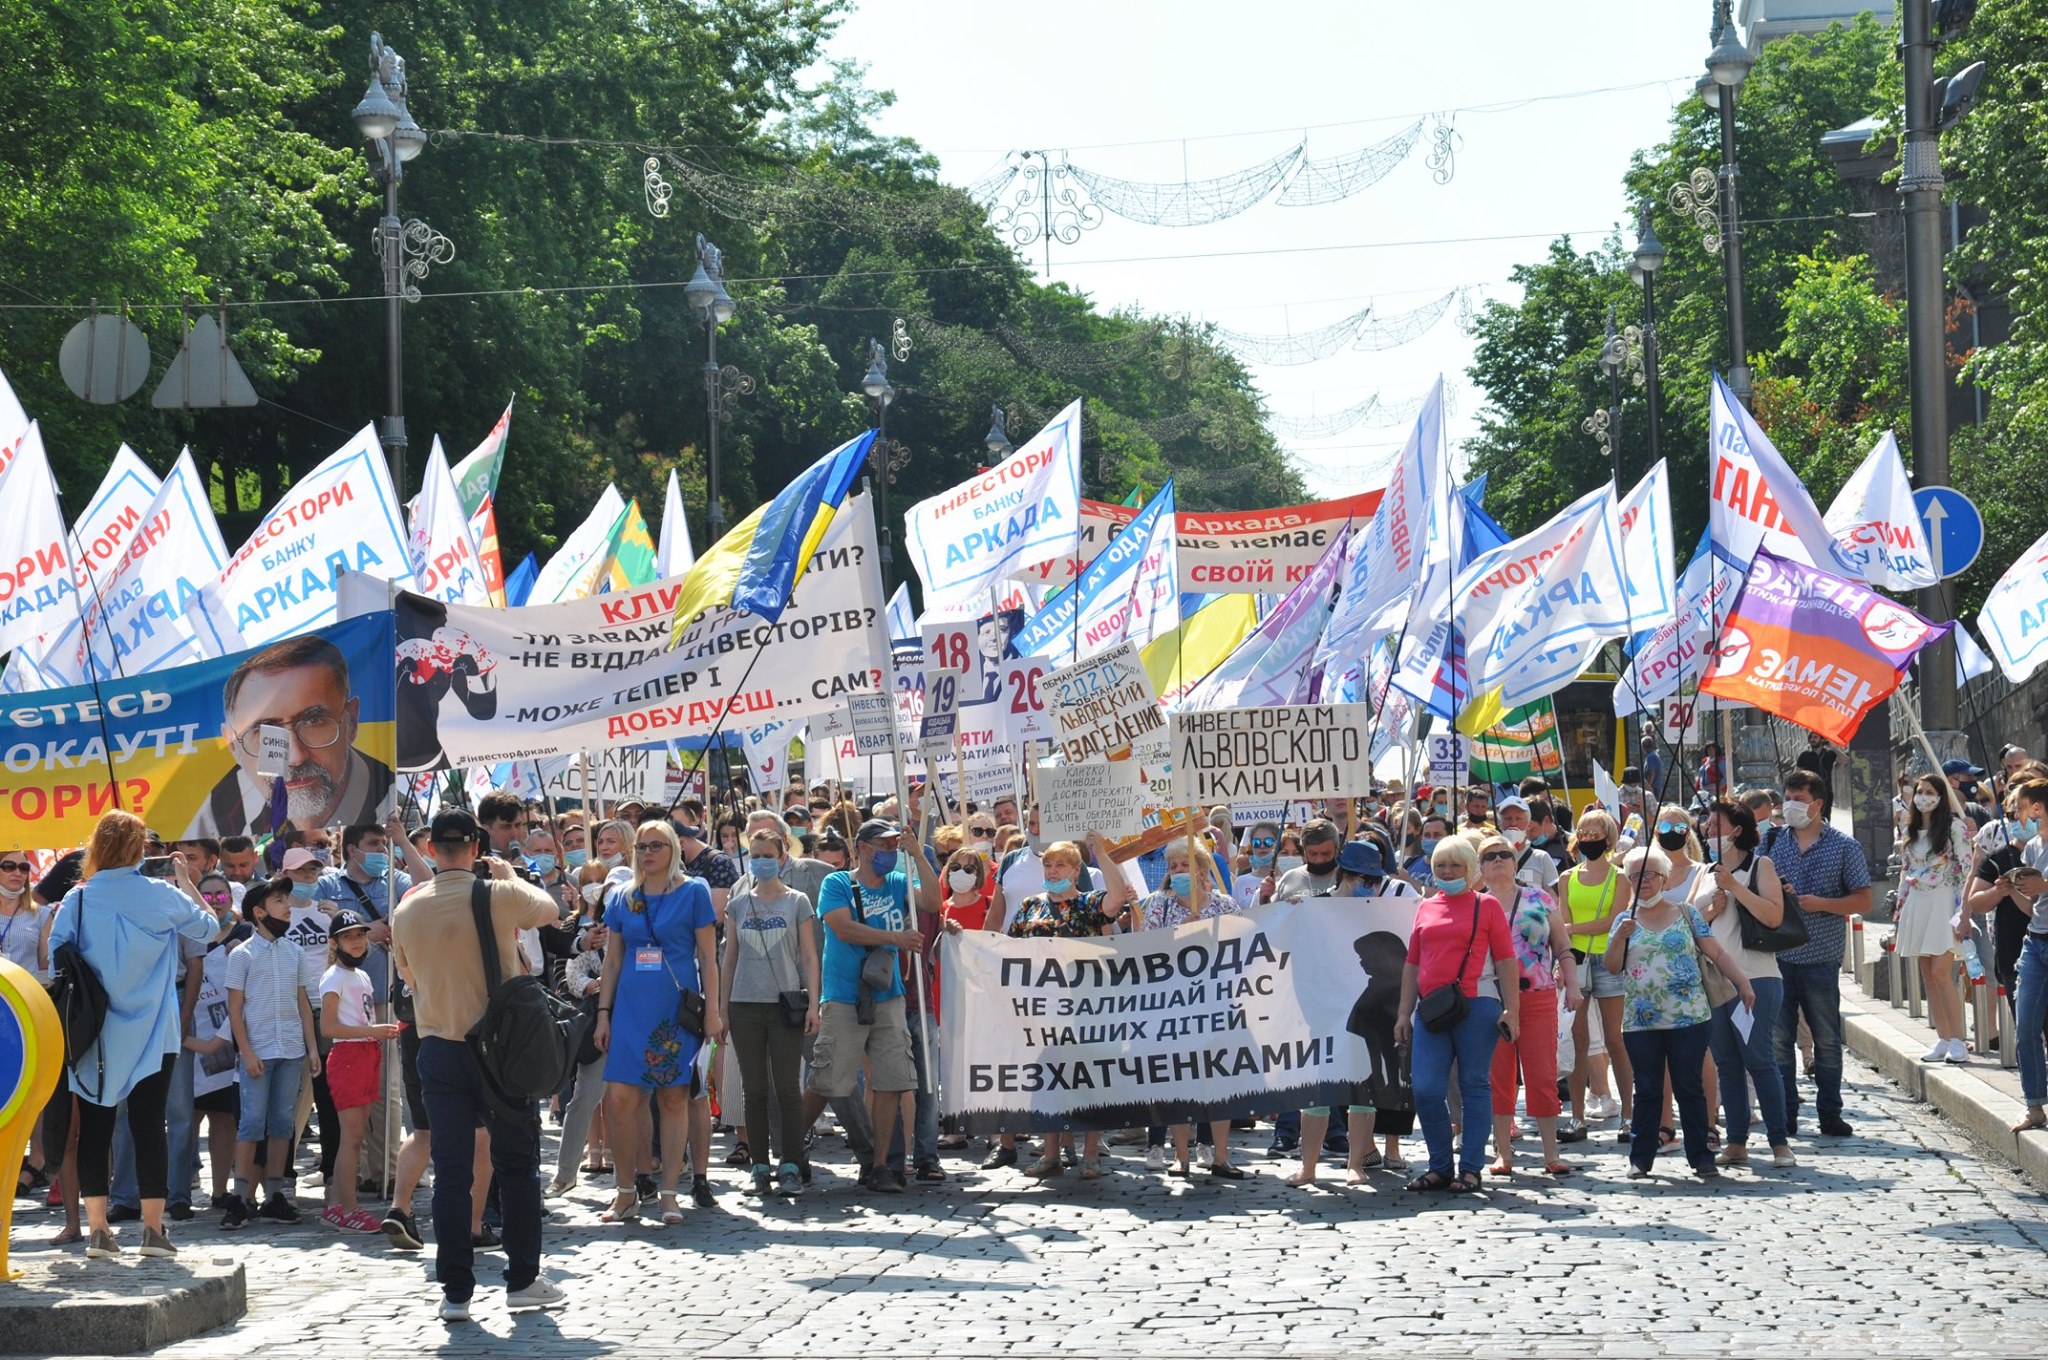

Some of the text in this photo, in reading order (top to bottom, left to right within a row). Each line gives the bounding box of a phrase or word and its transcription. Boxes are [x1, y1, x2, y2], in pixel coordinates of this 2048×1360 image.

[934, 447, 1053, 520] ІНВЕСТОРИ
[973, 489, 1024, 521] БАНКУ
[1185, 513, 1312, 535] Аркада,
[261, 533, 316, 571] БАНКУ
[945, 496, 1062, 569] АРКАДА
[1231, 529, 1327, 549] немає
[236, 540, 384, 634] АРКАДА
[1191, 559, 1274, 583] своїй
[601, 583, 682, 624] КЛИ
[684, 607, 877, 661] ІНВЕСТОРІВ?
[932, 632, 971, 674] 18
[509, 651, 556, 668] -НЕ
[505, 666, 722, 724] -МОЖЕ ТЕПЕР І
[811, 669, 884, 702] САМ?
[931, 675, 956, 714] 19
[1061, 664, 1119, 703] 2020
[1075, 685, 1114, 707] ОБМАН
[0, 691, 172, 728] ЄТЕСЬ
[607, 689, 803, 739] ДОБУДУЄШ...
[1060, 680, 1146, 733] ЛЬВОВСКИЙ
[1179, 707, 1334, 733] ИНВЕСТОРАМ
[1669, 703, 1694, 728] 20
[1182, 727, 1359, 769] ЛЬВОВСКОГО
[1435, 738, 1463, 759] 33
[0, 778, 151, 822] ОРИ?
[1200, 764, 1340, 799] !КЛЮЧИ!
[1064, 819, 1122, 833] ІНВЕСТОРІВ
[1235, 809, 1291, 821] МАХОВИК
[881, 908, 905, 932] 18
[1001, 932, 1291, 988] ПАЛИВОДА,
[1012, 975, 1274, 1017] НЕ ЗАЛИШАЙ НАС
[1024, 1028, 1035, 1047] І
[1041, 1020, 1147, 1047] НАШИХ
[1156, 1005, 1247, 1039] ДІТЕЙ
[968, 1036, 1335, 1093] БЕЗХАТЧЕНКАМИ!
